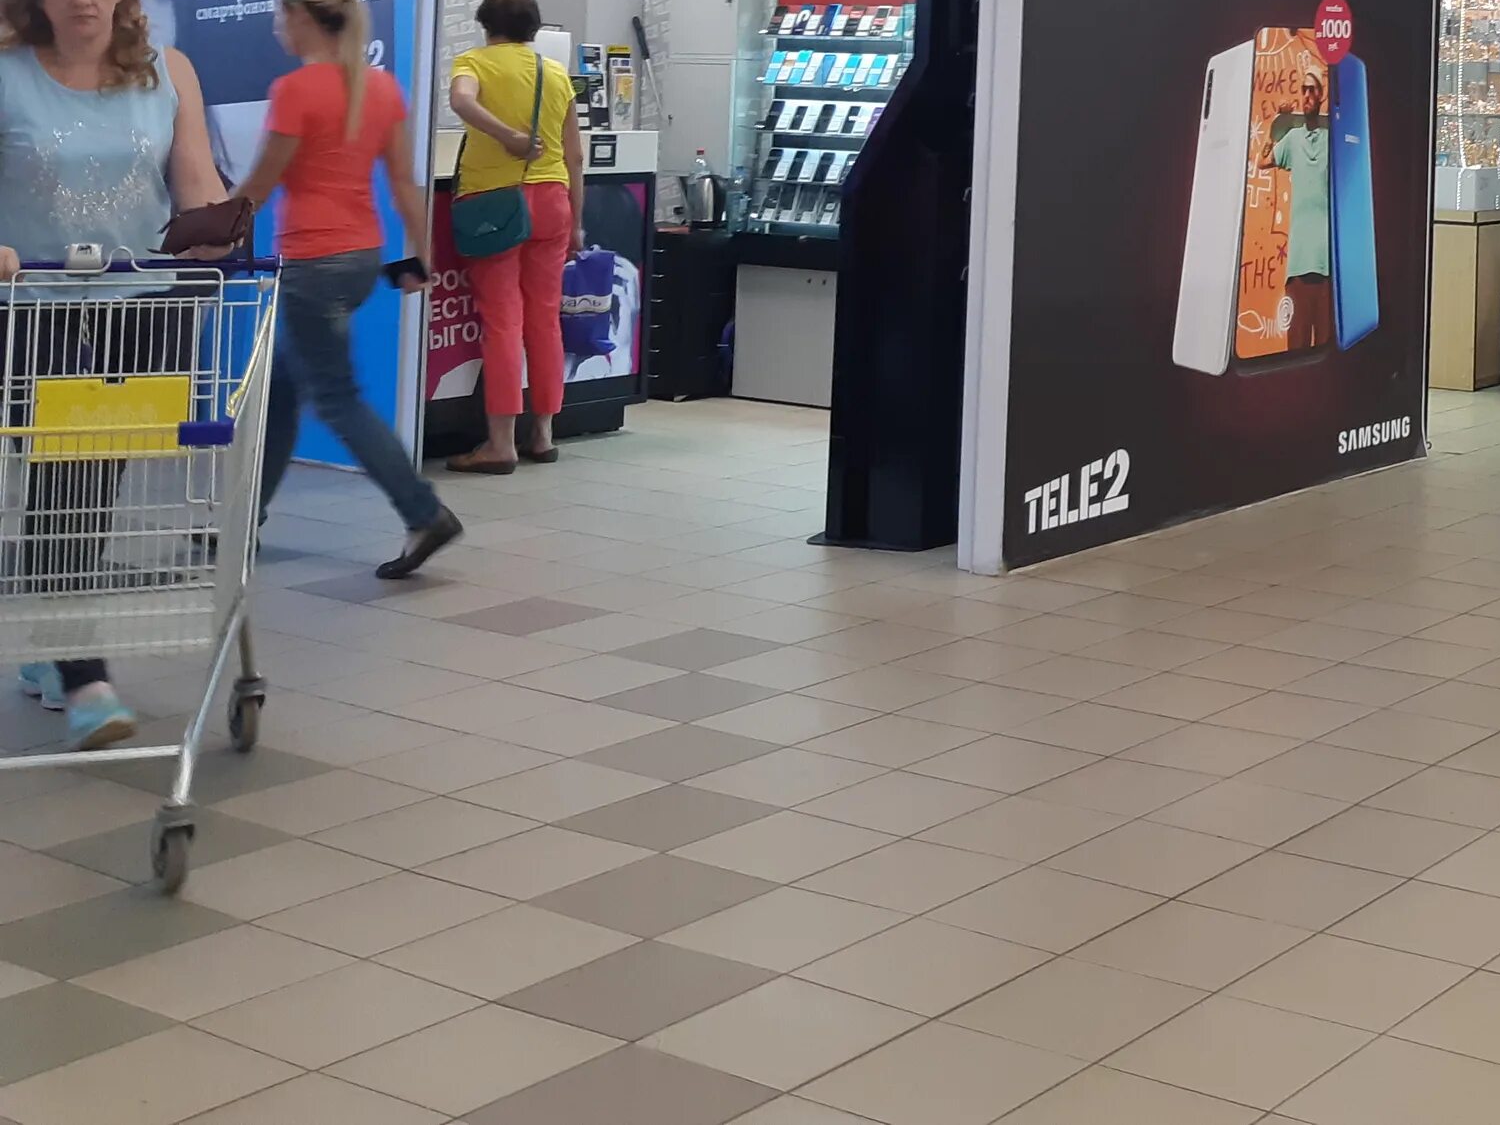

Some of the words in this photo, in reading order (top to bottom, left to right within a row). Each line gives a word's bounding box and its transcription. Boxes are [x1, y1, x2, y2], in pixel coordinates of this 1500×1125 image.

[1321, 19, 1351, 39] 1000
[430, 321, 483, 351] ЫГО
[1338, 416, 1411, 454] SAMSUNG
[1024, 448, 1131, 535] TELE2
